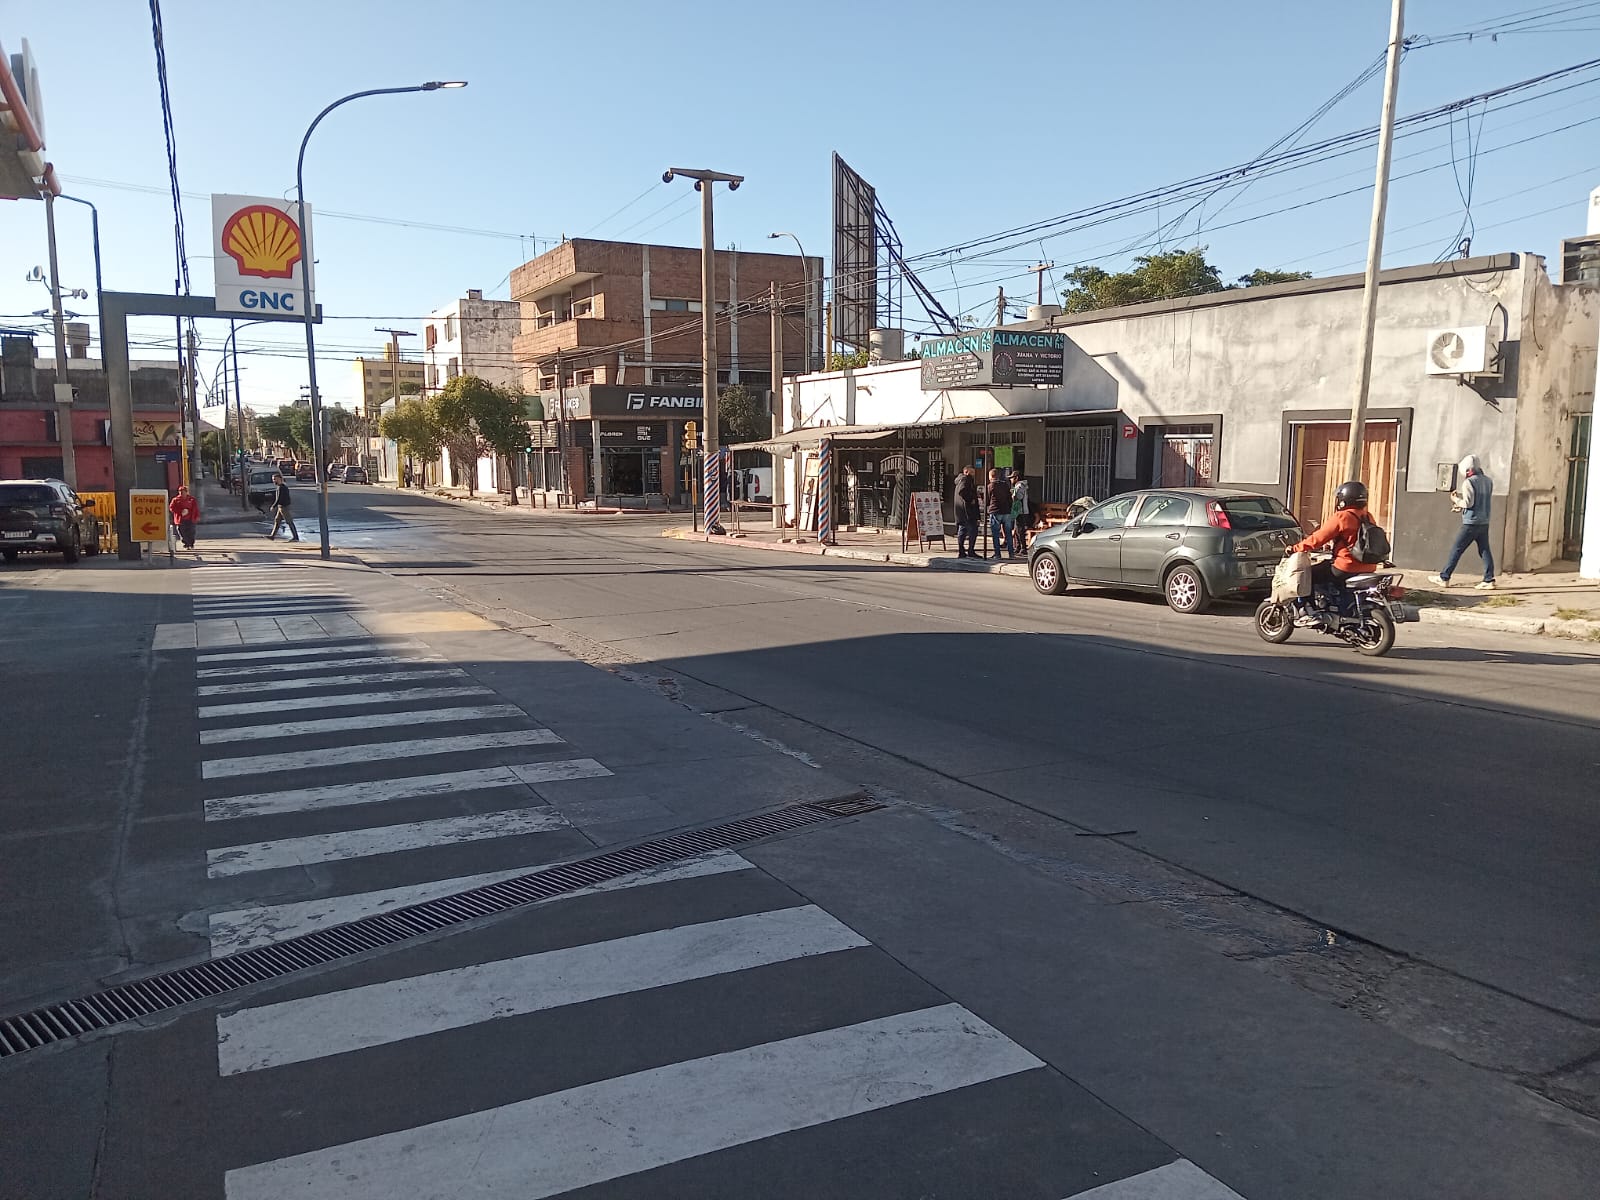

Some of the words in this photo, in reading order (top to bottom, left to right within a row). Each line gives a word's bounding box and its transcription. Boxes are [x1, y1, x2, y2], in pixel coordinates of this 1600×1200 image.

[239, 289, 294, 311] GNC
[981, 331, 992, 341] 24
[993, 333, 1052, 349] ALMACEN
[1054, 333, 1064, 342] 24
[922, 335, 979, 359] ALMACEN
[650, 397, 703, 408] FANBI
[897, 429, 922, 440] BRBER
[925, 427, 943, 440] SHOP
[133, 496, 165, 504] Entrada
[135, 506, 162, 516] GNC
